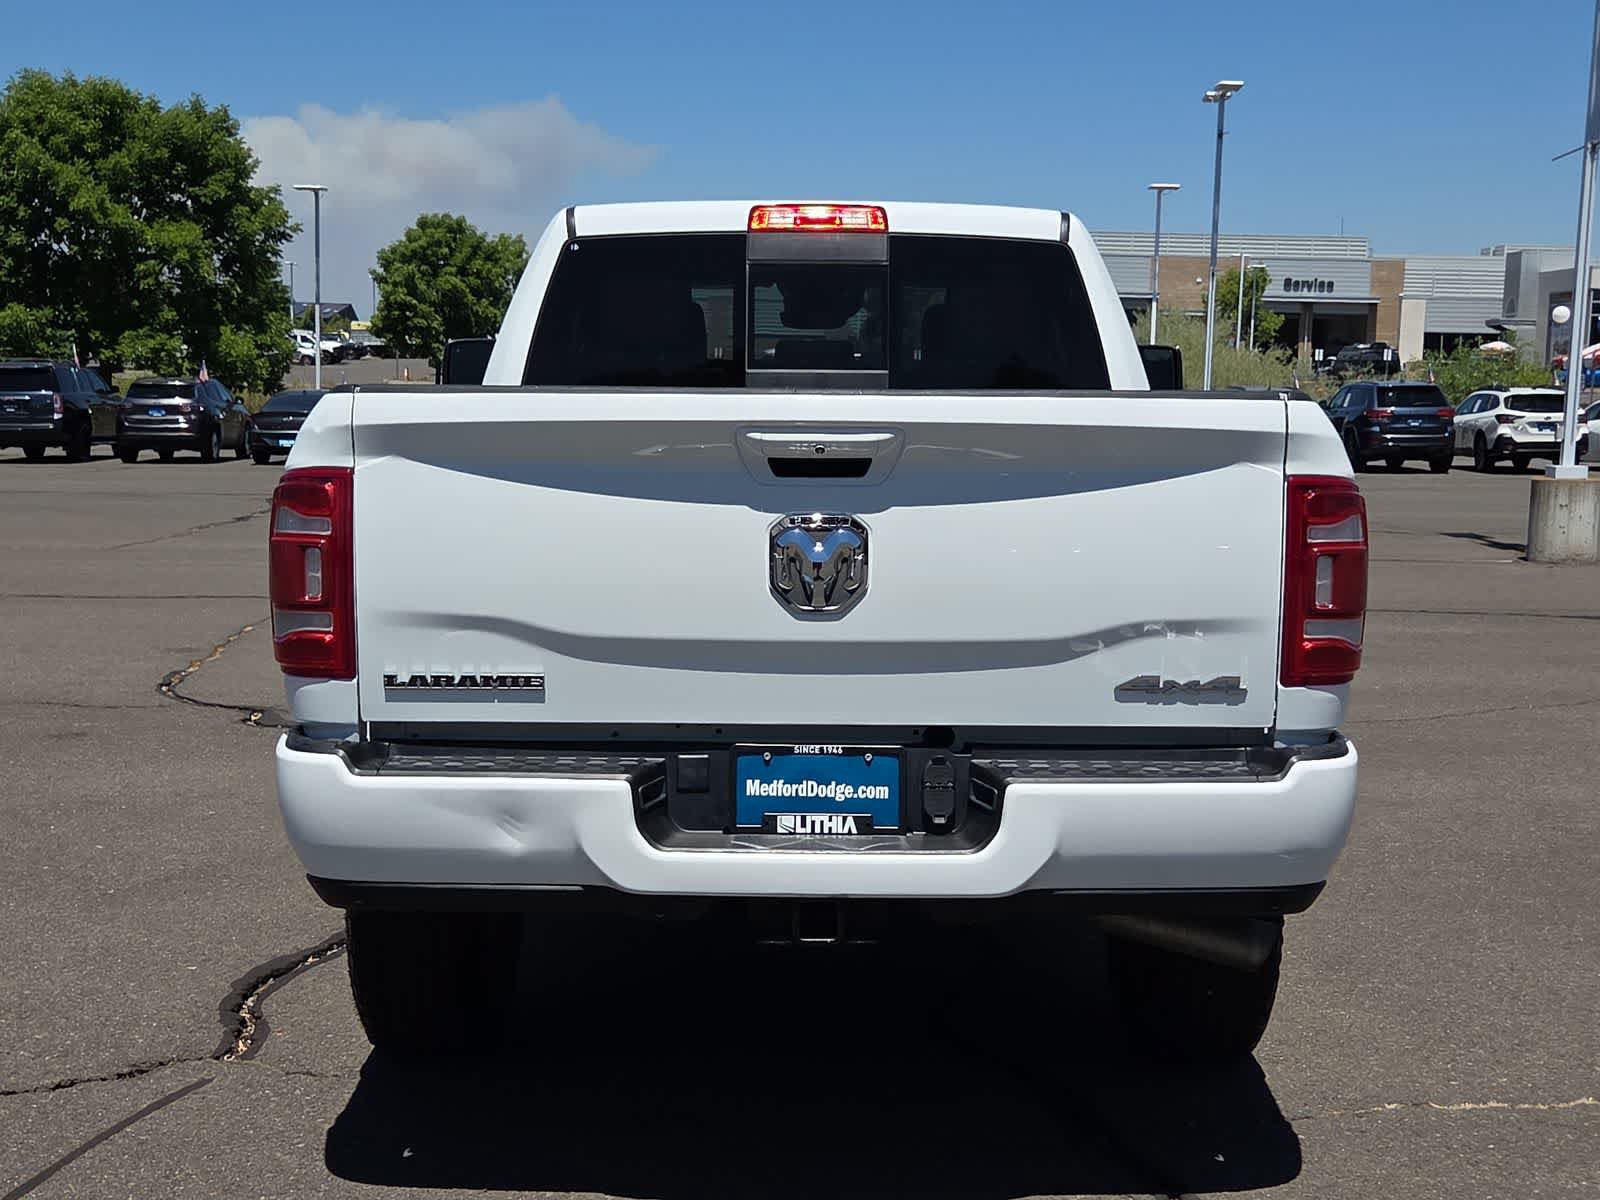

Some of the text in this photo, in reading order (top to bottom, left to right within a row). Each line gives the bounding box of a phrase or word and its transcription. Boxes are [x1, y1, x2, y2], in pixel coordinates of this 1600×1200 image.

[1283, 277, 1334, 293] Service
[384, 673, 544, 690] LARAMIE
[794, 745, 843, 755] SINCE 1946
[746, 779, 889, 801] MedfordDodge.com
[795, 815, 858, 834] LITHIA
